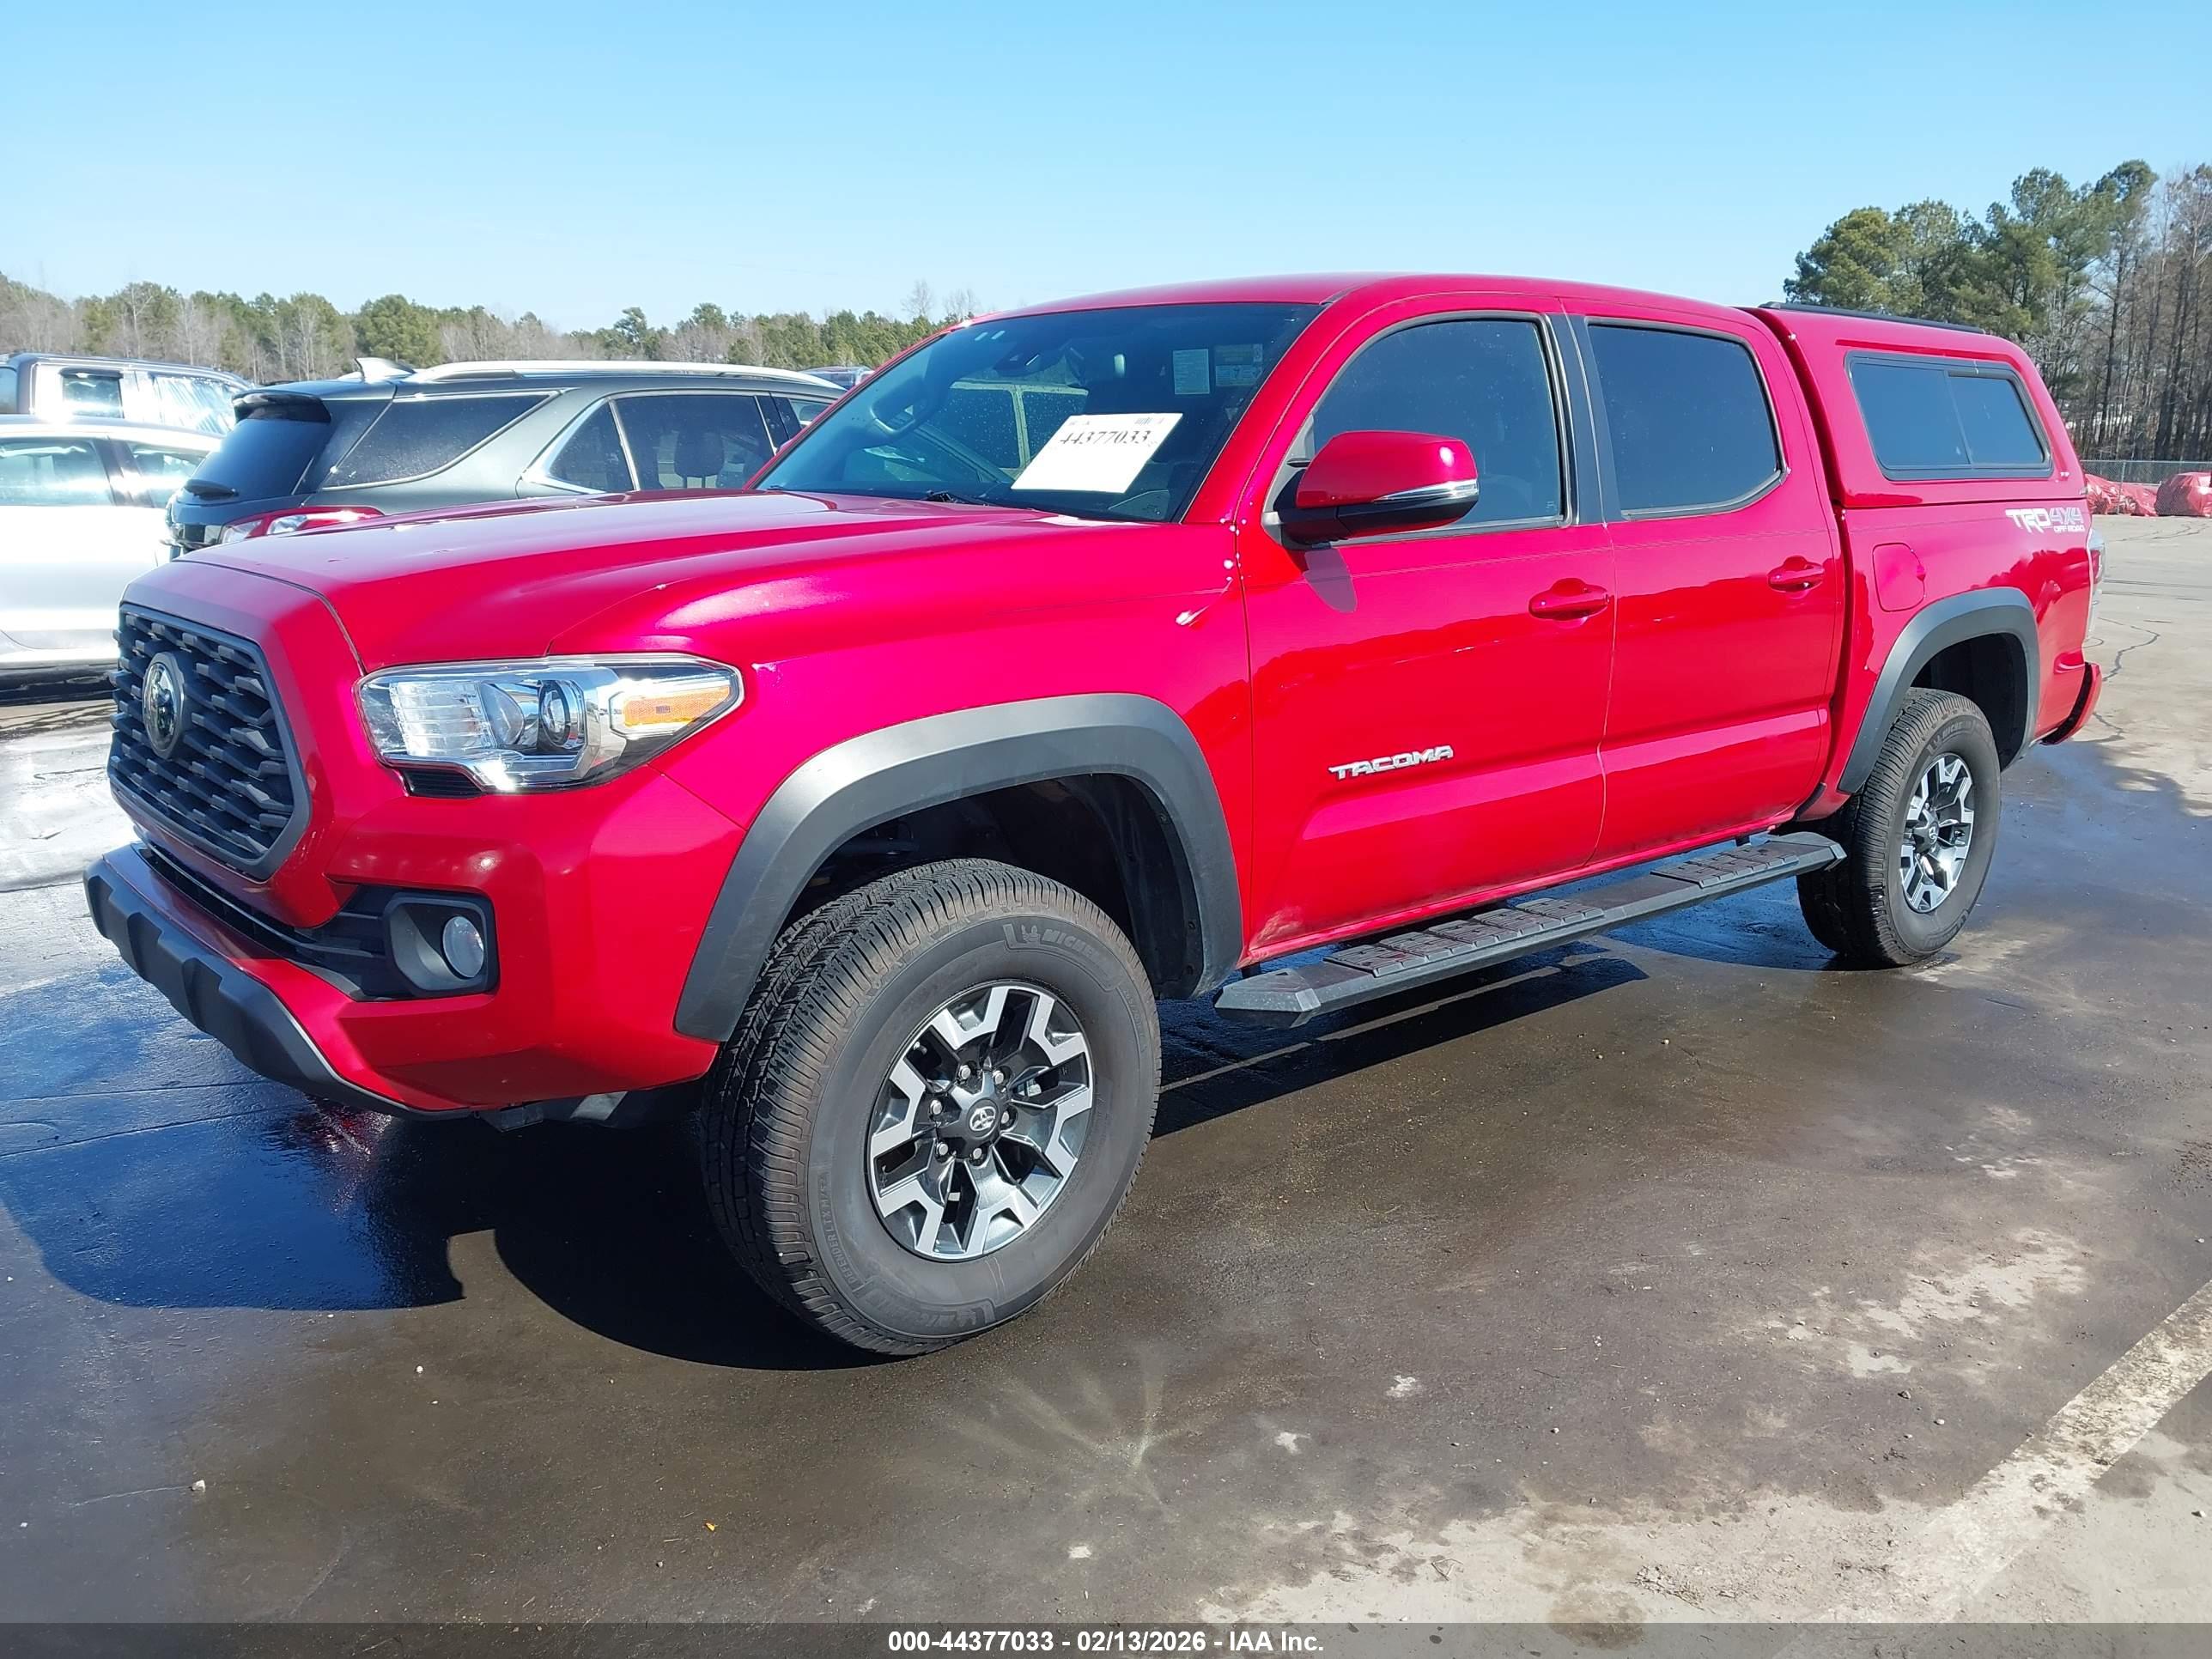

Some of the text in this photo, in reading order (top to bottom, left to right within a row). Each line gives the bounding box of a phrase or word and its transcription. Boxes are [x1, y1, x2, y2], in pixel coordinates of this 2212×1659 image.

[1060, 430, 1152, 445] 44377033
[2005, 508, 2051, 533] TRD
[1328, 745, 1454, 780] TACOMA
[828, 1234, 858, 1284] DEFENDER
